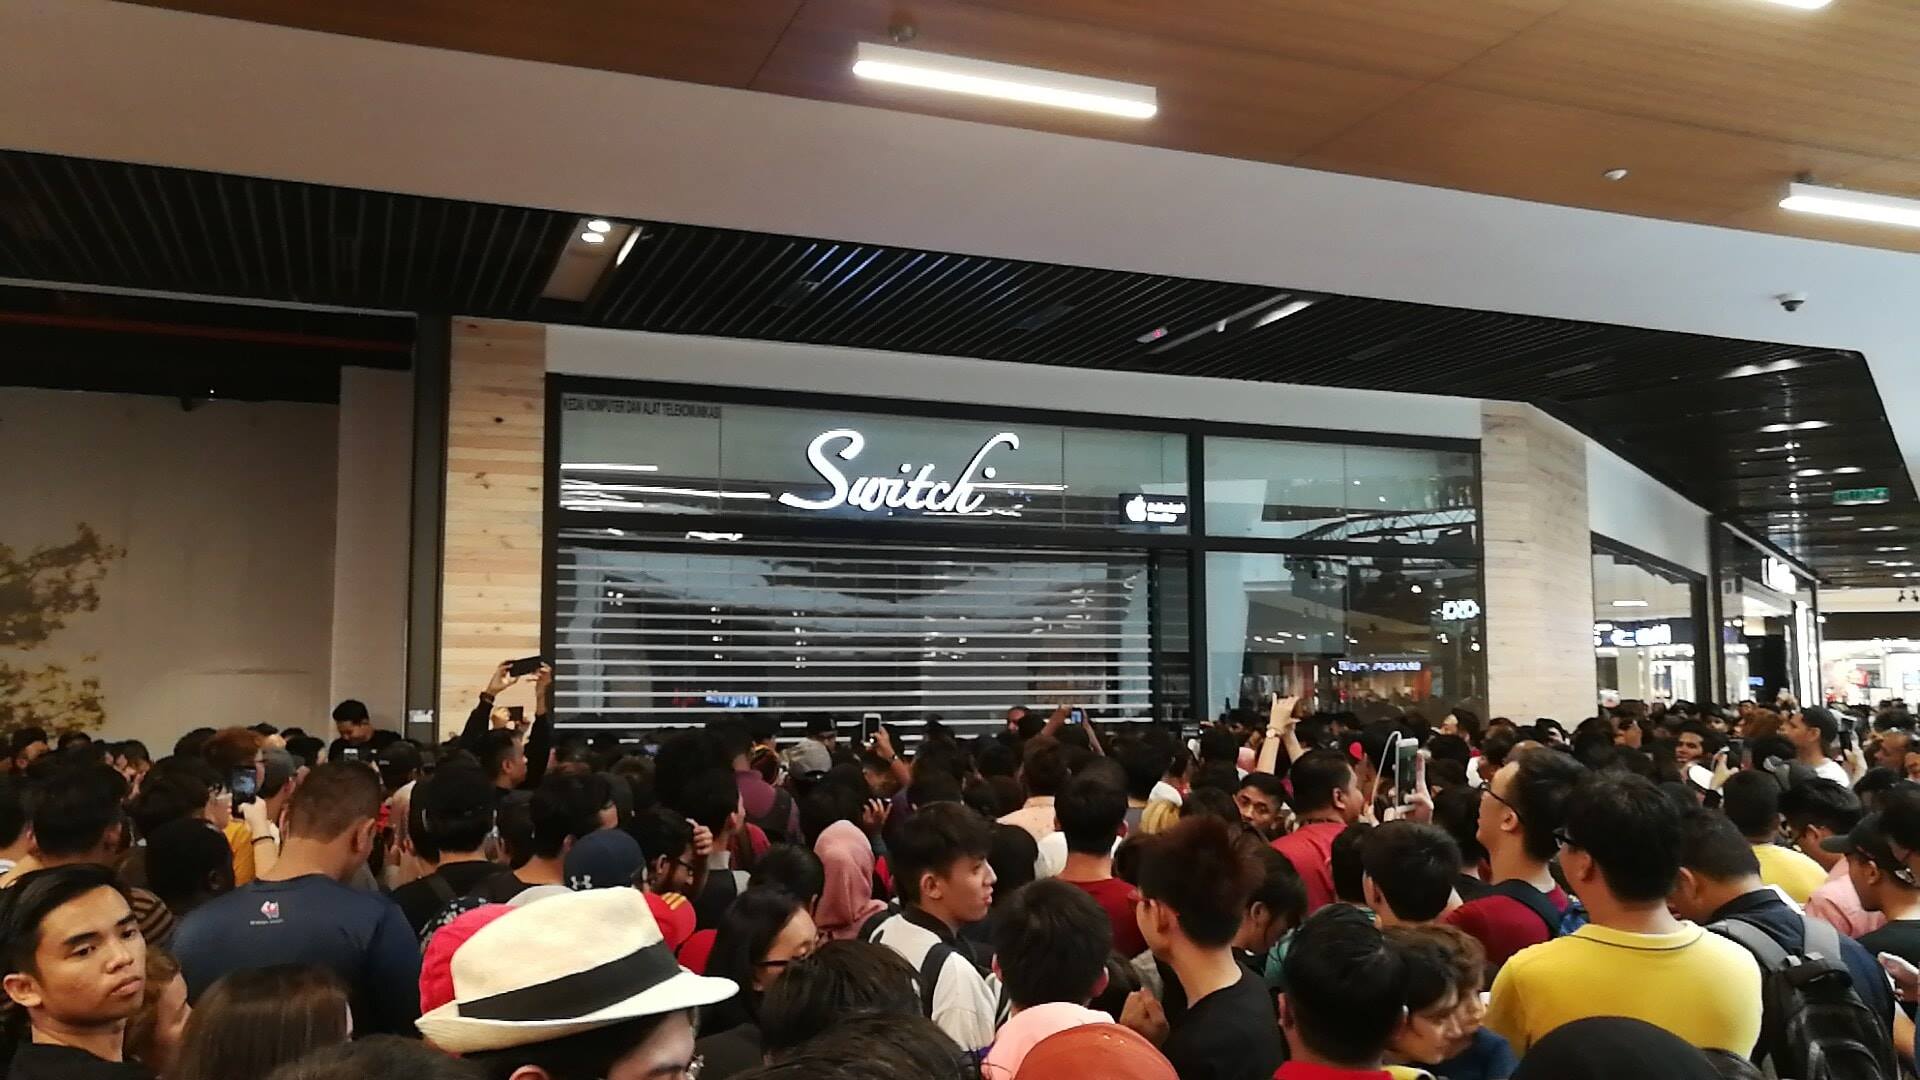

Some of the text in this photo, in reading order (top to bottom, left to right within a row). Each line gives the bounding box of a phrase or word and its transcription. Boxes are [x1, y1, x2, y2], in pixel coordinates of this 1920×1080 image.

[627, 401, 641, 415] DAN
[643, 402, 662, 416] ALAT
[778, 429, 1019, 513] Switch
